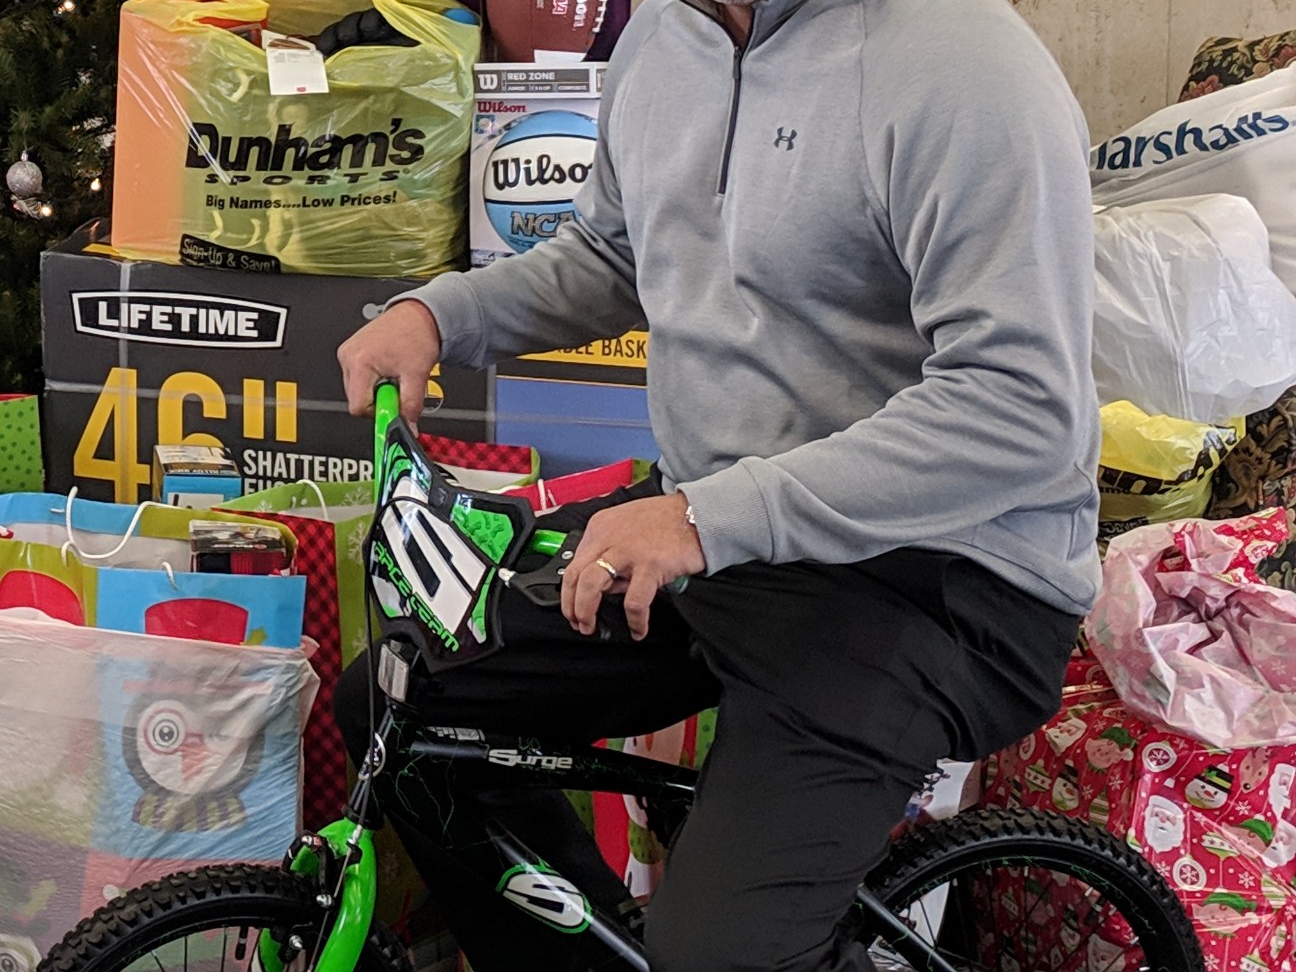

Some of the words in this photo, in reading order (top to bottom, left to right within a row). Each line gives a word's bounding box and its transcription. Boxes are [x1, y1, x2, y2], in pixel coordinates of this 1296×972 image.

[507, 72, 526, 81] RED
[528, 71, 555, 80] ZONE
[477, 100, 526, 113] Wilson
[185, 117, 426, 172] Dunham's
[1095, 111, 1290, 170] arshalls
[204, 169, 401, 186] SPORTS
[492, 153, 593, 191] Wilso
[205, 195, 225, 210] Big
[340, 190, 397, 207] Prices!
[511, 209, 578, 238] NC
[226, 252, 237, 267] &
[98, 300, 259, 338] LIFETIME
[601, 338, 647, 359] BASK
[243, 449, 374, 482] SHATTERPR
[488, 749, 573, 770] Surge
